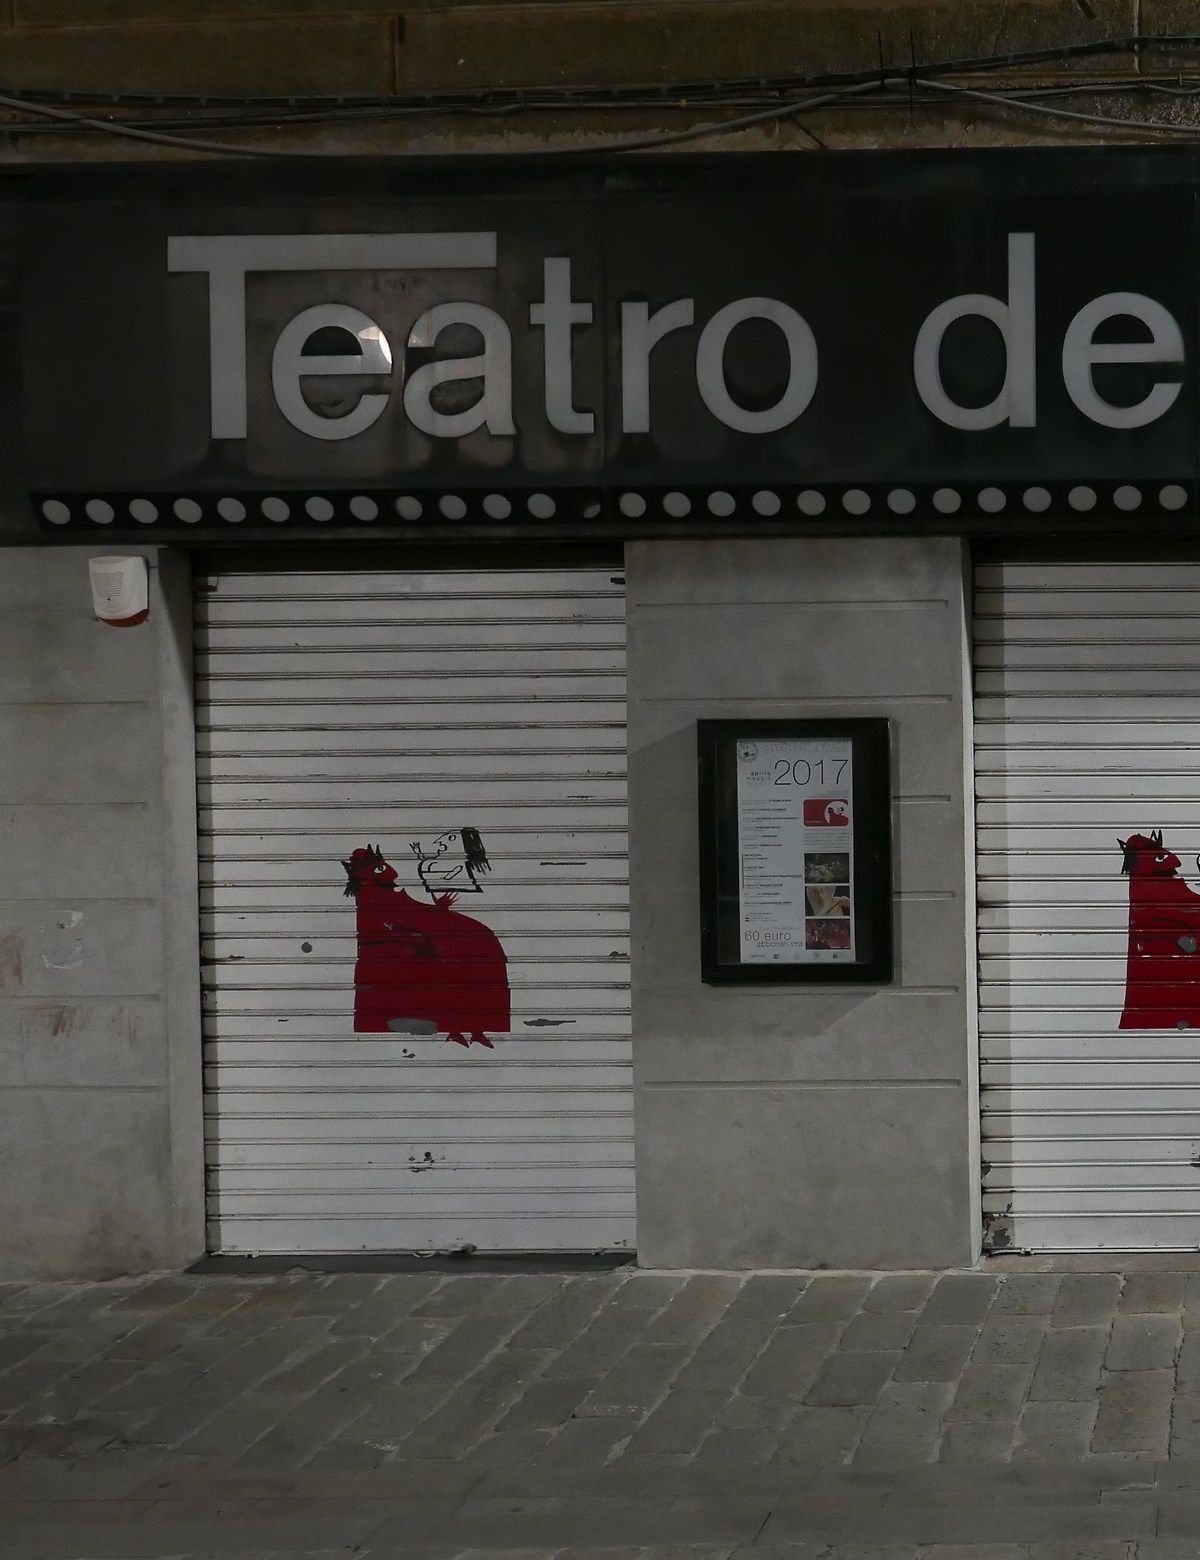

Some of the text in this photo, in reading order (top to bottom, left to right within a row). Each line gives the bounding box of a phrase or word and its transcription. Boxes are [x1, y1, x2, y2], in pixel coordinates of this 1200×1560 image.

[167, 232, 818, 440] Teatro
[774, 759, 848, 785] 2017
[744, 931, 792, 941] 60 euro
[756, 940, 789, 948] abbonati
